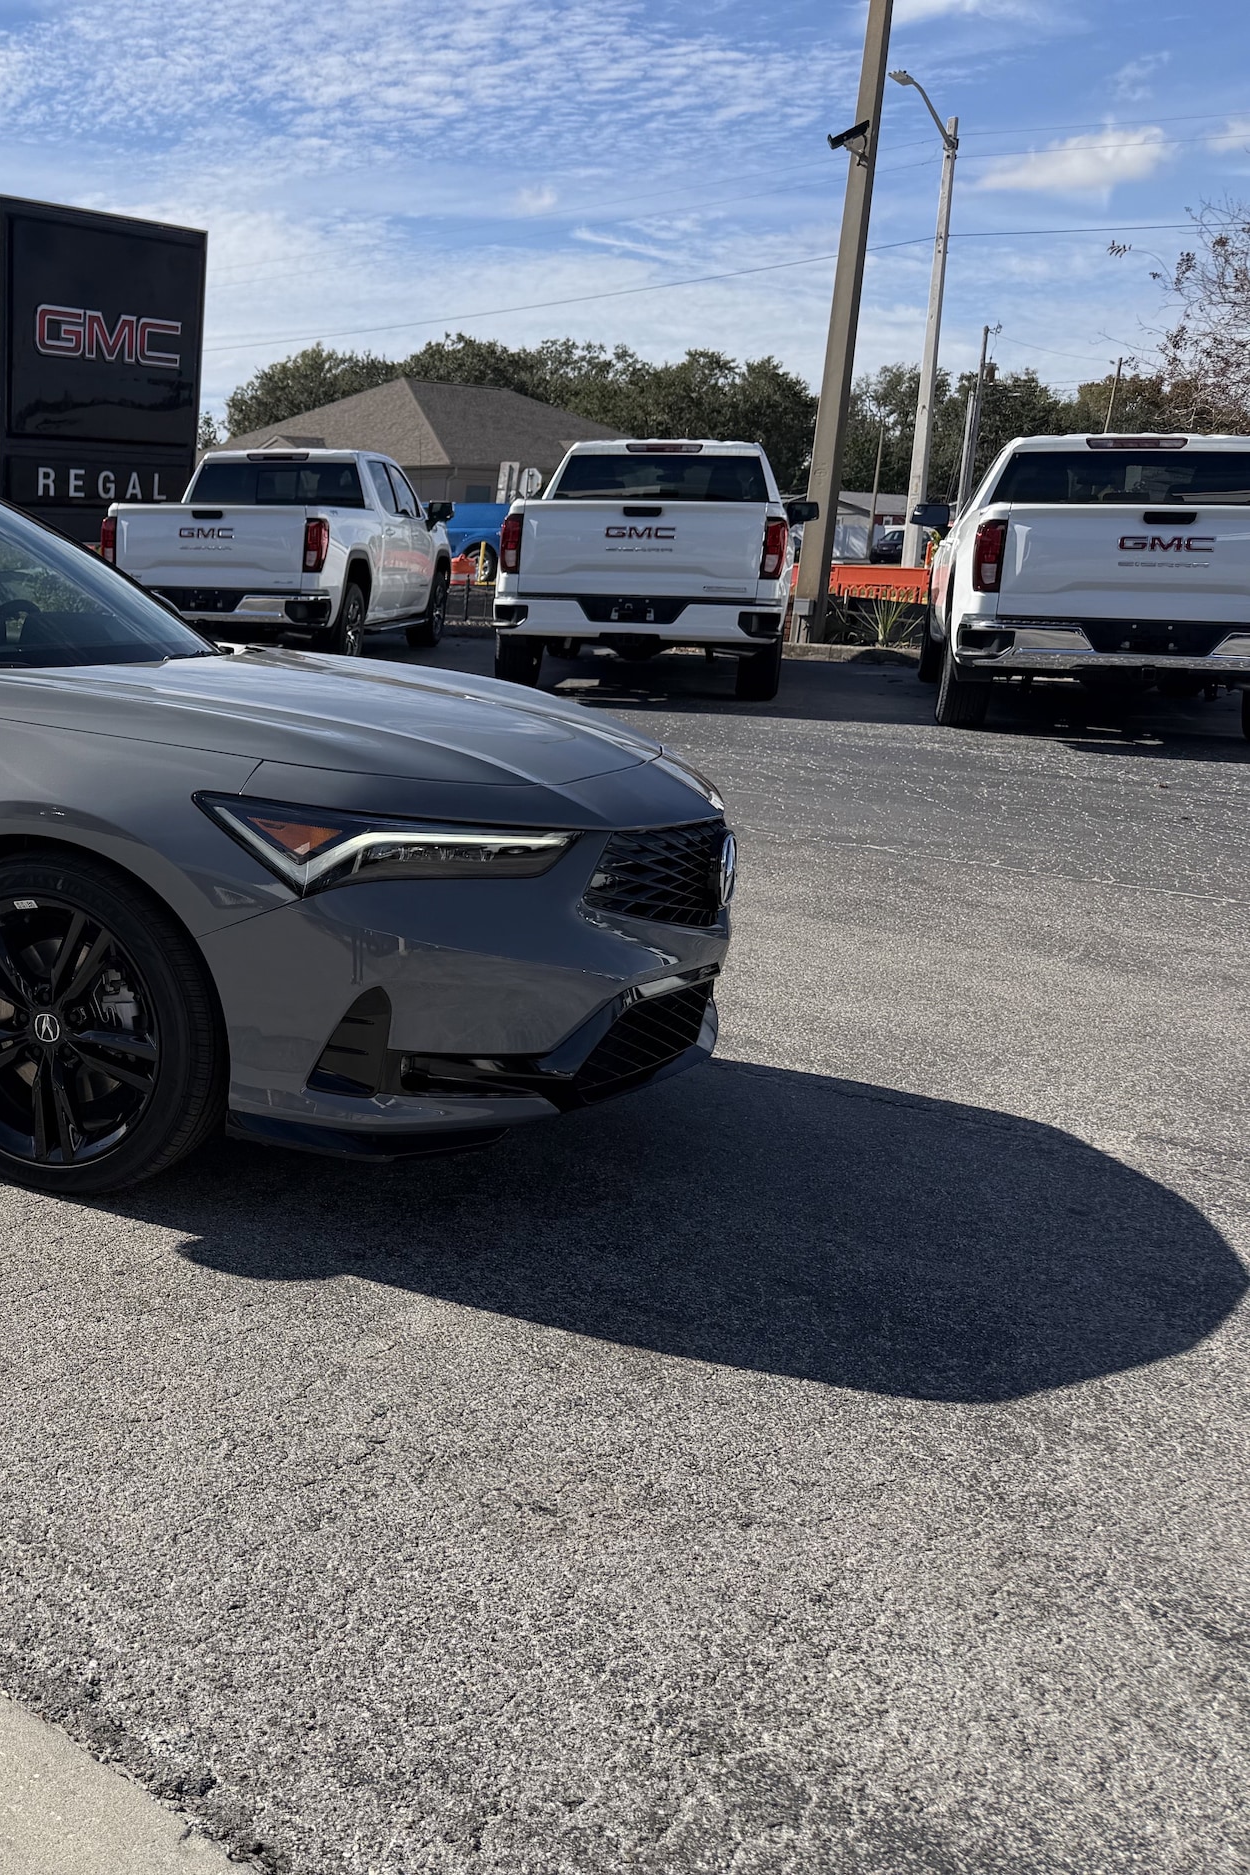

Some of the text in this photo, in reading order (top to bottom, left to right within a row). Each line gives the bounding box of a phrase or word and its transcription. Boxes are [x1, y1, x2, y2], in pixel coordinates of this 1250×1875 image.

[36, 304, 182, 367] GMC
[37, 467, 167, 500] REGAL
[179, 527, 235, 539] GMC
[605, 526, 676, 540] GMC
[1118, 536, 1216, 552] GMC
